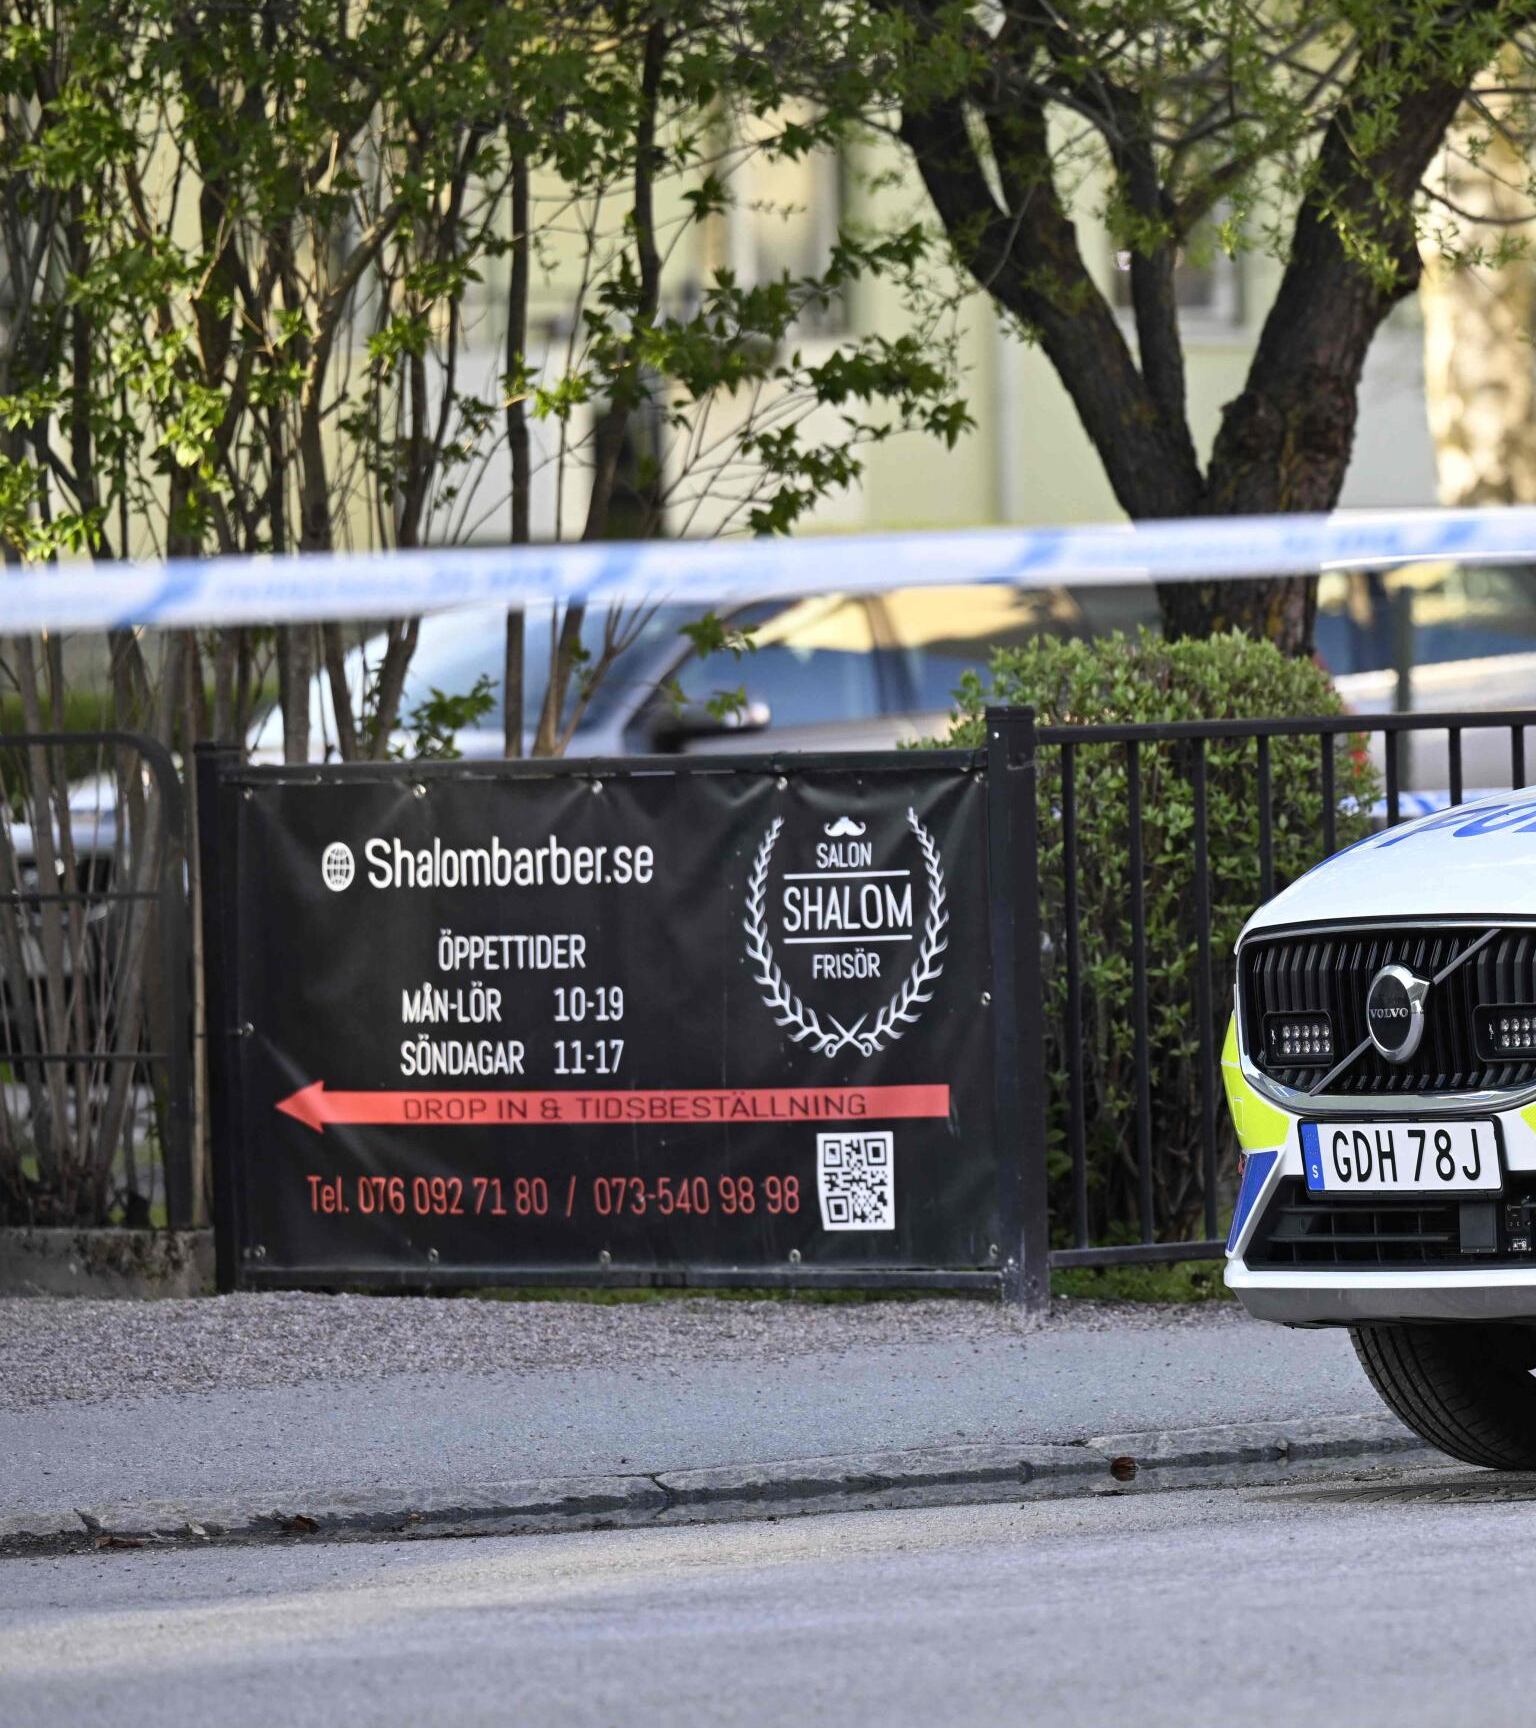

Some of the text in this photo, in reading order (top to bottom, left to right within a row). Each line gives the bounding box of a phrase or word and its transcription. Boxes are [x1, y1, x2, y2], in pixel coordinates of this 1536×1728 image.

[364, 834, 654, 890] Shalombarber.se
[815, 841, 873, 869] SALON
[782, 881, 913, 931] SHALOM
[438, 928, 586, 972] ÖPPETTIDER
[812, 947, 881, 980] FRISÖR
[401, 980, 624, 1024] MÅN-LÖR 10-19
[1369, 1007, 1409, 1018] VOLVO
[400, 1033, 624, 1077] SÖNDAGAR 11-17
[404, 1091, 867, 1121] DROP IN & TIDSBESTÄLLNING
[1311, 1164, 1320, 1179] S
[1332, 1128, 1481, 1183] GDH 78J
[307, 1174, 800, 1218] Tel. 076 092 71 80 / 073-540 98 98
